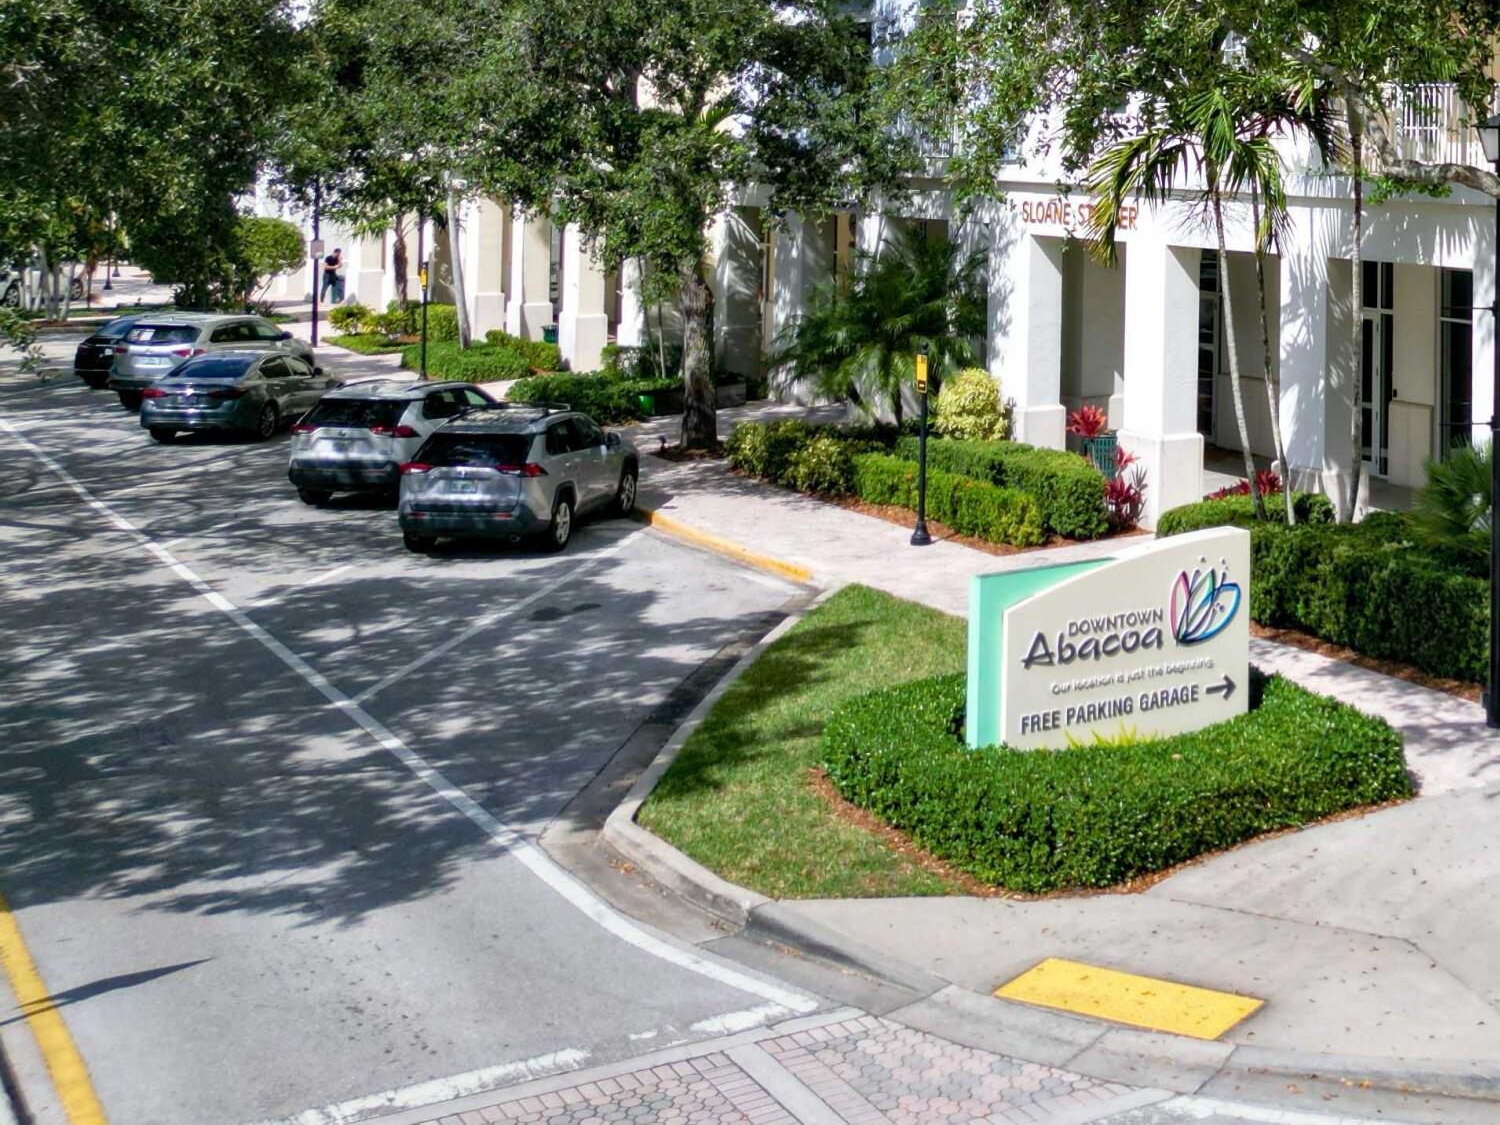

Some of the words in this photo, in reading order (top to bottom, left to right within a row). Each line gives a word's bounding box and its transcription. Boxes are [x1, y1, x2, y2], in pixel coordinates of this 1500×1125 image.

[1022, 200, 1071, 225] SLOANE
[1068, 608, 1164, 637] DOWNTOWN
[1021, 626, 1164, 670] Abacoa
[1051, 681, 1071, 695] Our
[1073, 674, 1114, 691] location
[1146, 664, 1163, 678] the
[1021, 711, 1061, 735] FREE
[1066, 695, 1134, 727] PARKING
[1139, 683, 1200, 714] GARAGE
